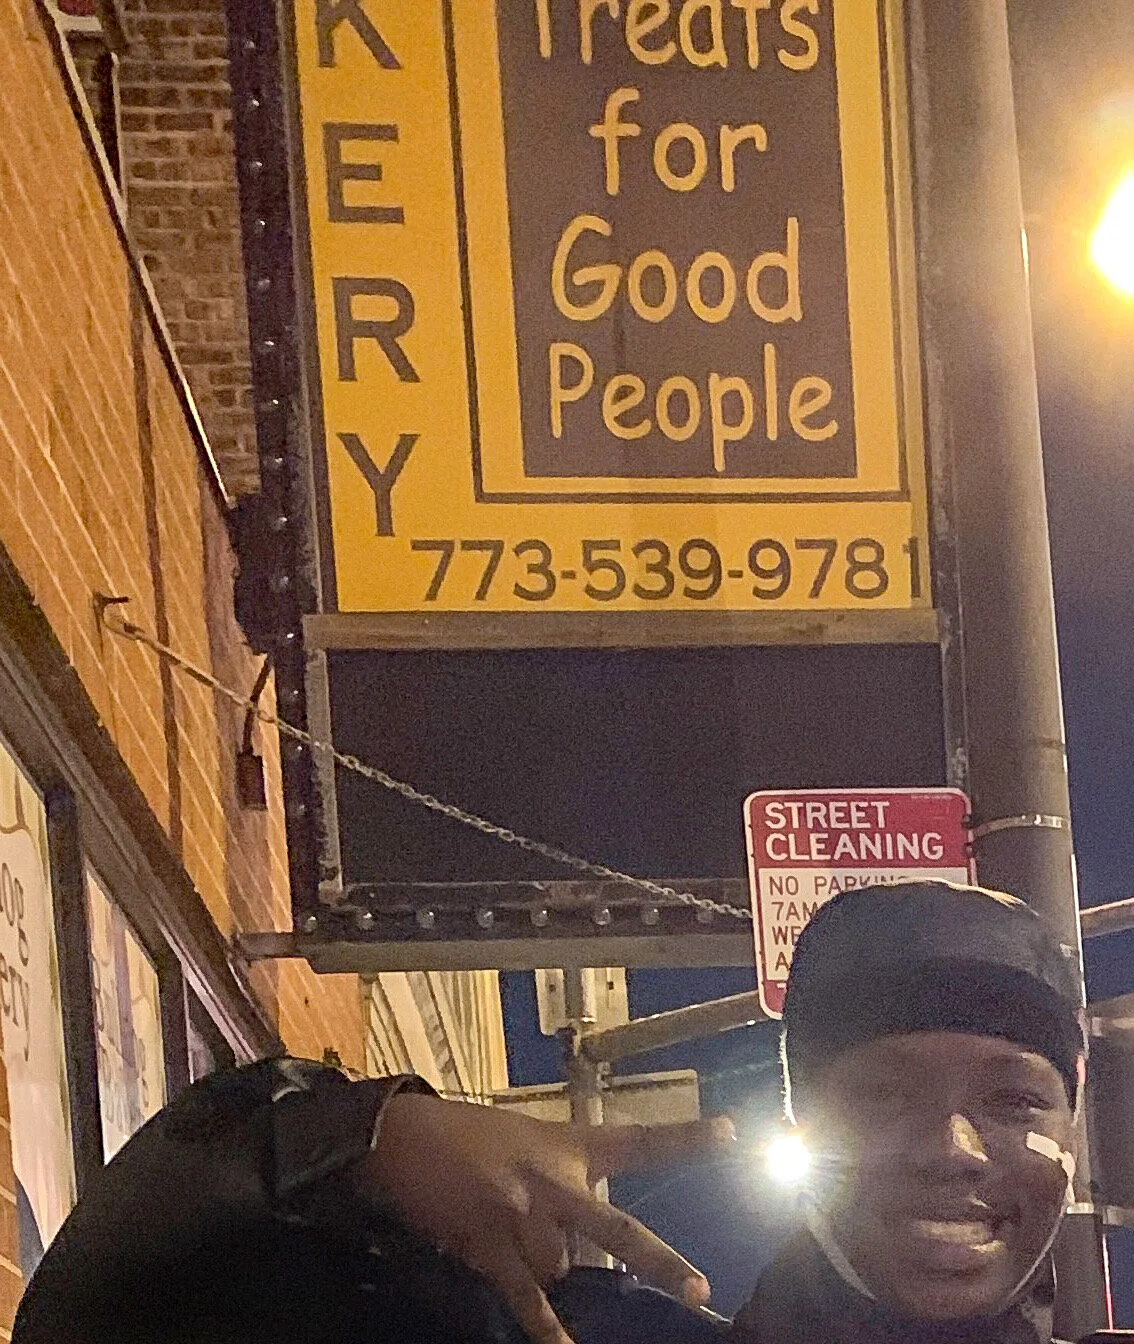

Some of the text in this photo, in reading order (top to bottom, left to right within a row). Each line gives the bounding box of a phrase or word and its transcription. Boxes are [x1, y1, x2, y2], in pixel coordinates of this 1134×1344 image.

[590, 87, 768, 196] for
[551, 214, 803, 325] Good
[550, 342, 839, 473] People
[410, 537, 924, 602] 773-539-9781
[764, 801, 890, 830] STREET
[765, 832, 945, 862] CLEANING
[769, 875, 799, 896] NO
